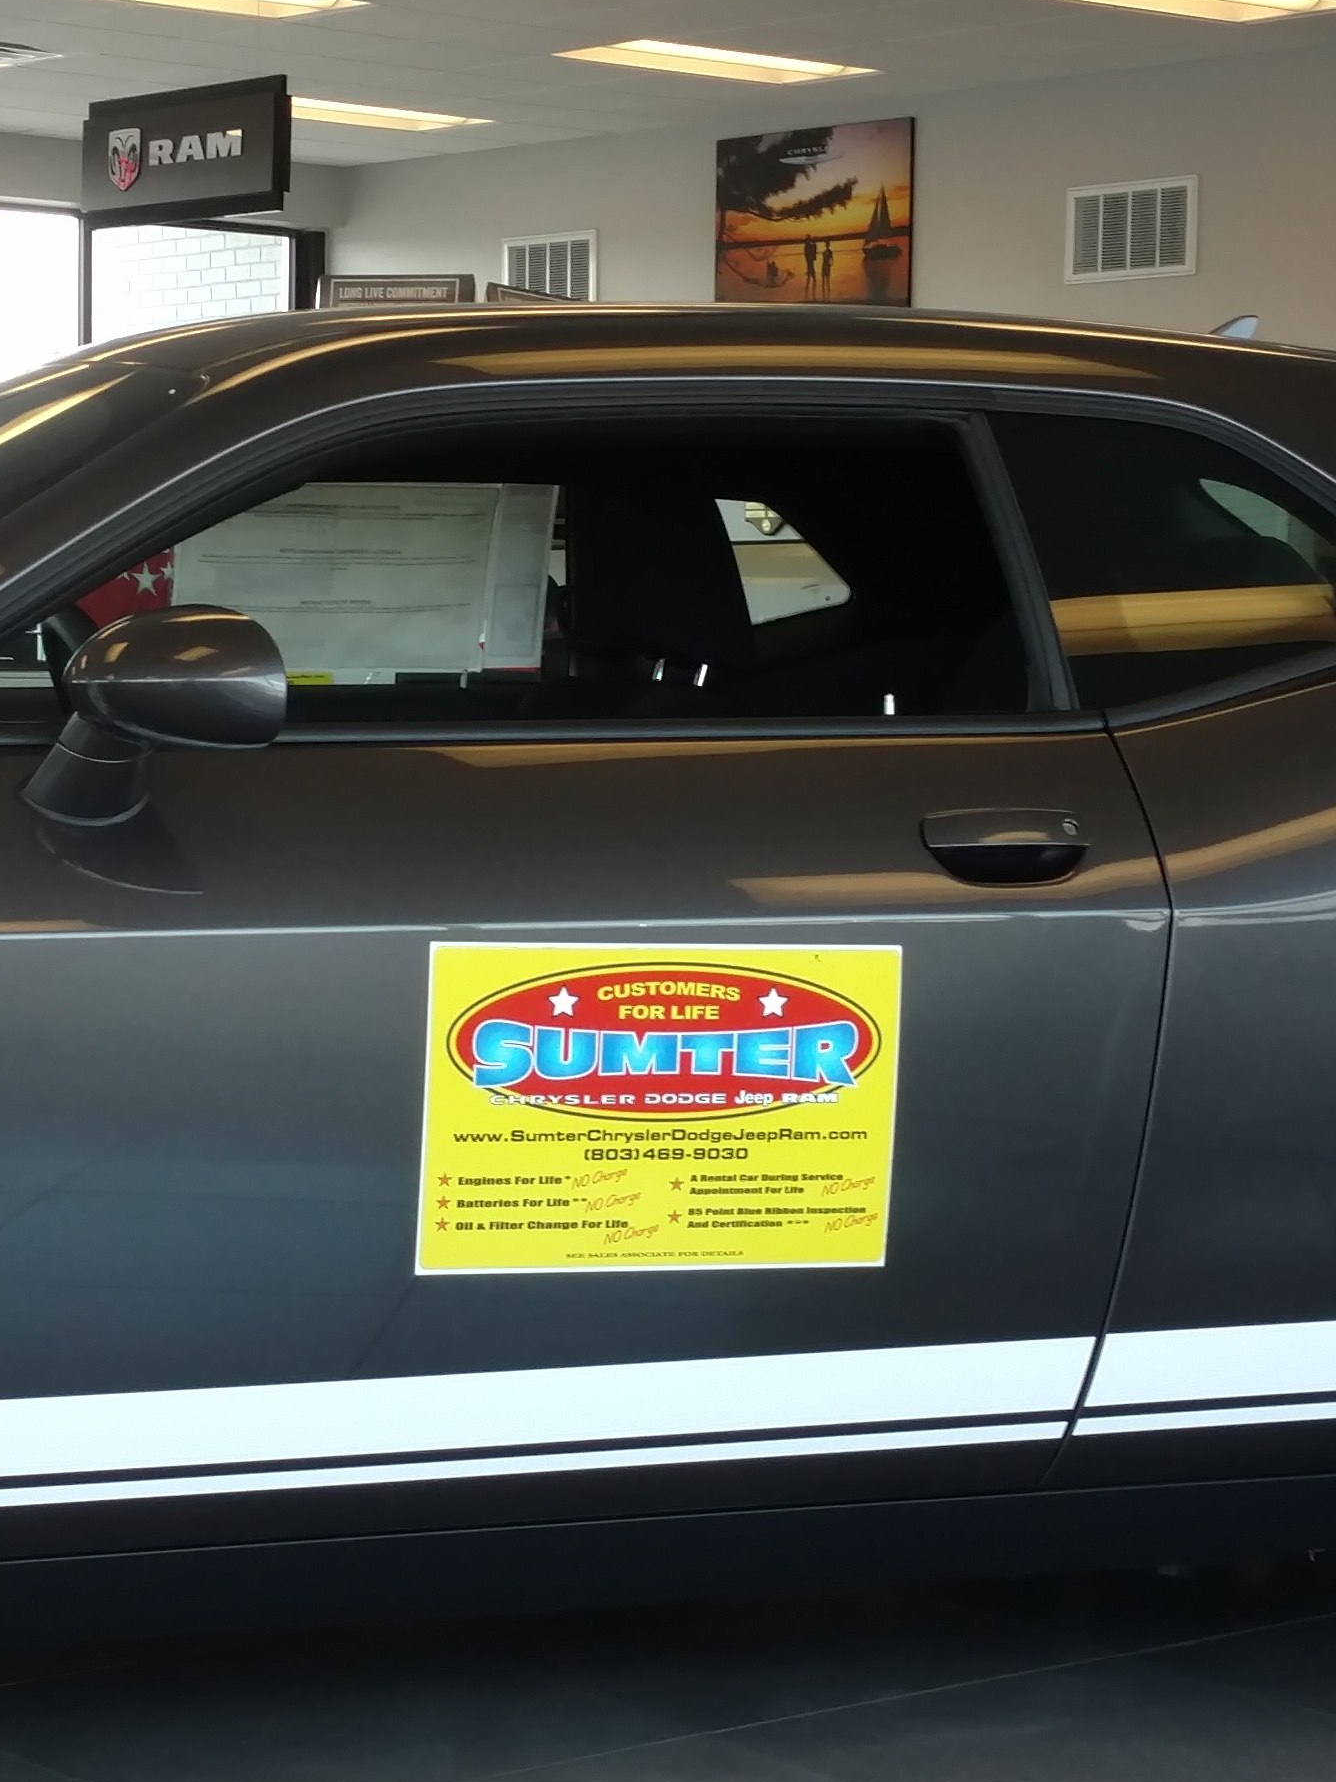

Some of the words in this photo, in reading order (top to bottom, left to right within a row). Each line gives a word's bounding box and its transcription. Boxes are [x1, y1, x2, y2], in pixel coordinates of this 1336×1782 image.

[148, 128, 243, 167] RAM
[339, 287, 362, 299] LONG
[364, 287, 384, 299] LIVE
[386, 287, 448, 298] COMMITMENT
[596, 980, 741, 1004] CUSTOMERS
[618, 1005, 665, 1021] FOR
[671, 1005, 720, 1021] LIFE
[472, 1019, 859, 1089] SUMTER
[489, 1093, 636, 1106] CHRYSLER
[644, 1092, 727, 1105] DODGE
[734, 1089, 774, 1108] Jeep
[781, 1092, 839, 1104] RAM
[453, 1128, 868, 1146] www.SumterChryslerDodgeJeepRam.com
[458, 1176, 511, 1187] Engines
[514, 1175, 536, 1185] For
[570, 1173, 592, 1190] NO
[690, 1174, 698, 1183] A
[700, 1174, 737, 1182] Rental
[739, 1174, 759, 1182] Car
[762, 1174, 799, 1183] During
[801, 1173, 844, 1182] Service
[689, 1186, 763, 1196] Appointment
[765, 1186, 782, 1195] For
[784, 1185, 805, 1194] Life
[821, 1182, 840, 1197] NO
[456, 1199, 520, 1209] Batteries
[522, 1199, 544, 1207] For
[584, 1197, 604, 1214] NO
[705, 1207, 734, 1215] Point
[736, 1207, 763, 1215] Blue
[764, 1207, 804, 1215] Ribbon
[806, 1205, 867, 1216] Inspection
[455, 1221, 474, 1231] Oil
[476, 1223, 486, 1231] &
[488, 1221, 524, 1231] Filter
[527, 1219, 579, 1231] Change
[582, 1220, 602, 1229] For
[605, 1219, 629, 1229] Life
[687, 1220, 709, 1229] And
[711, 1219, 783, 1229] Certification
[824, 1217, 843, 1233] NO
[603, 1229, 623, 1246] NO
